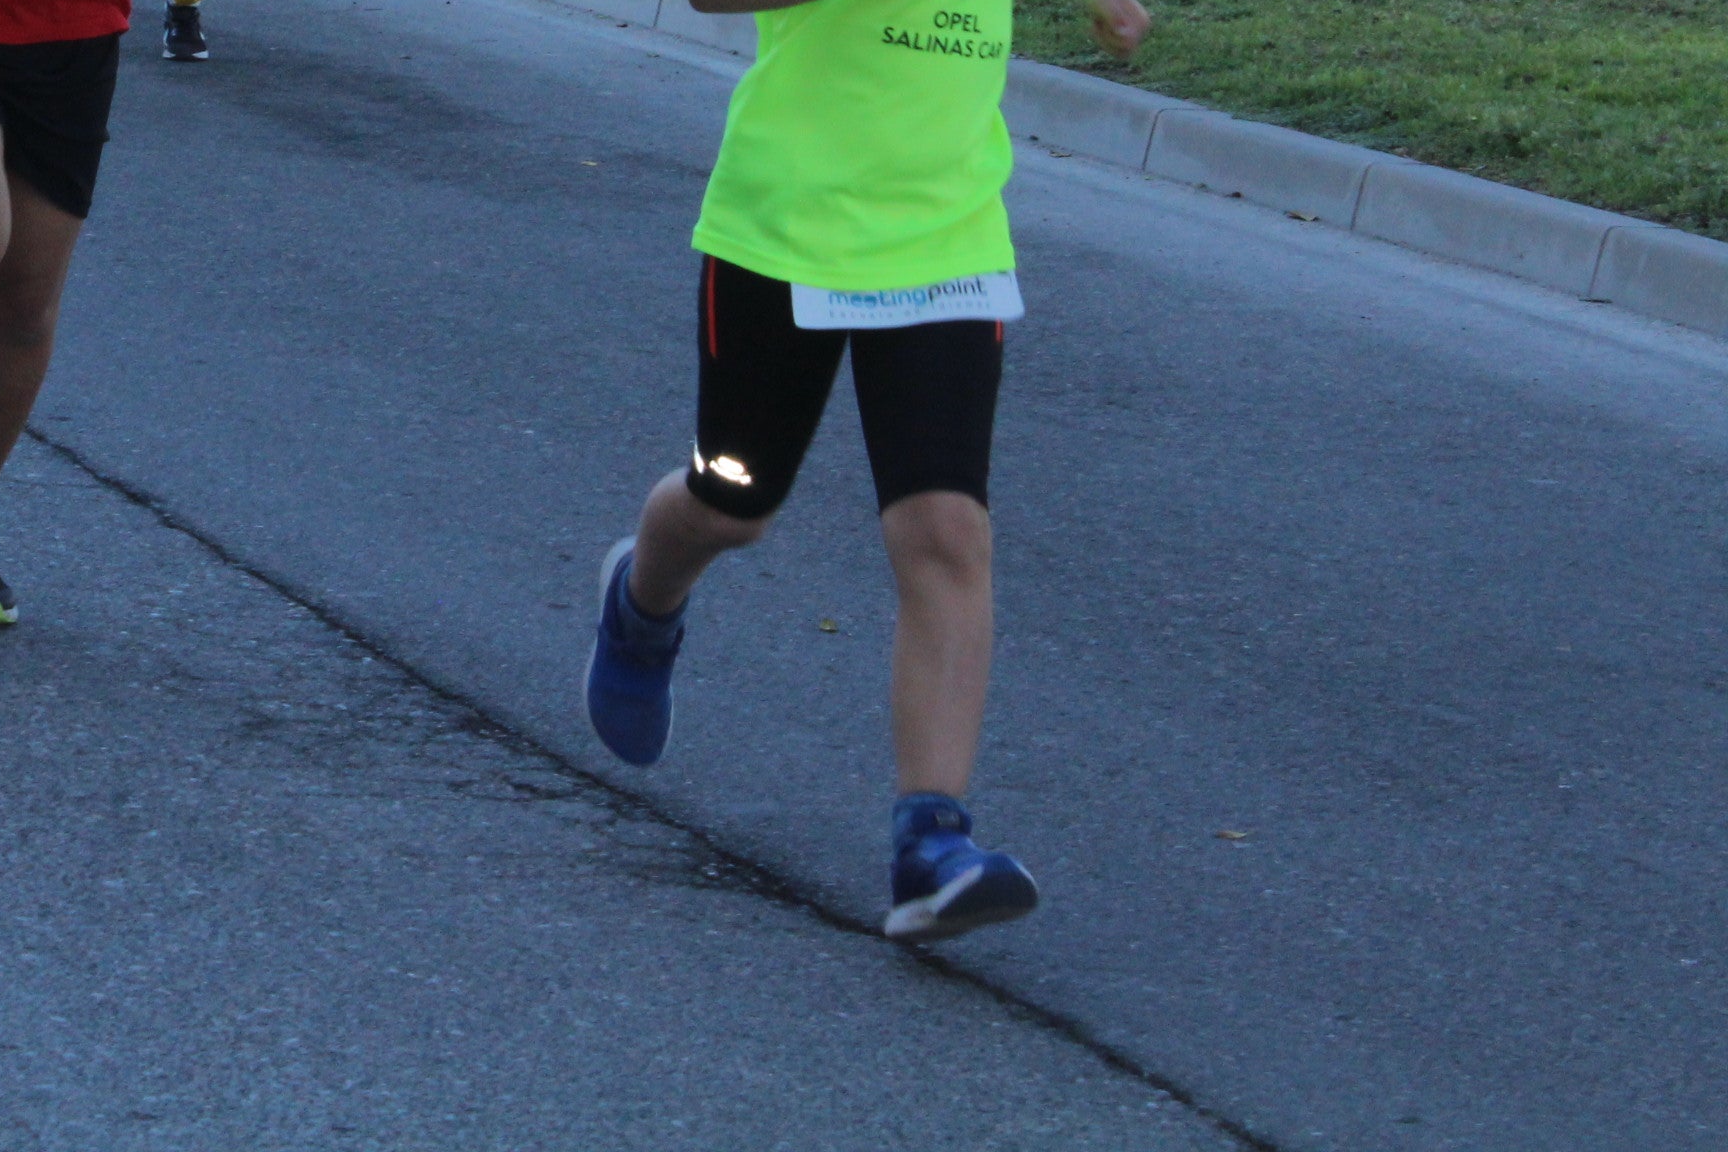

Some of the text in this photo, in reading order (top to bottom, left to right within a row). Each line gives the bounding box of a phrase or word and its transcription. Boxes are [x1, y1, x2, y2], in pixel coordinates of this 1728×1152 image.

[934, 11, 982, 33] OPEL
[881, 26, 975, 59] SALINAS
[828, 277, 985, 308] meetingpoint
